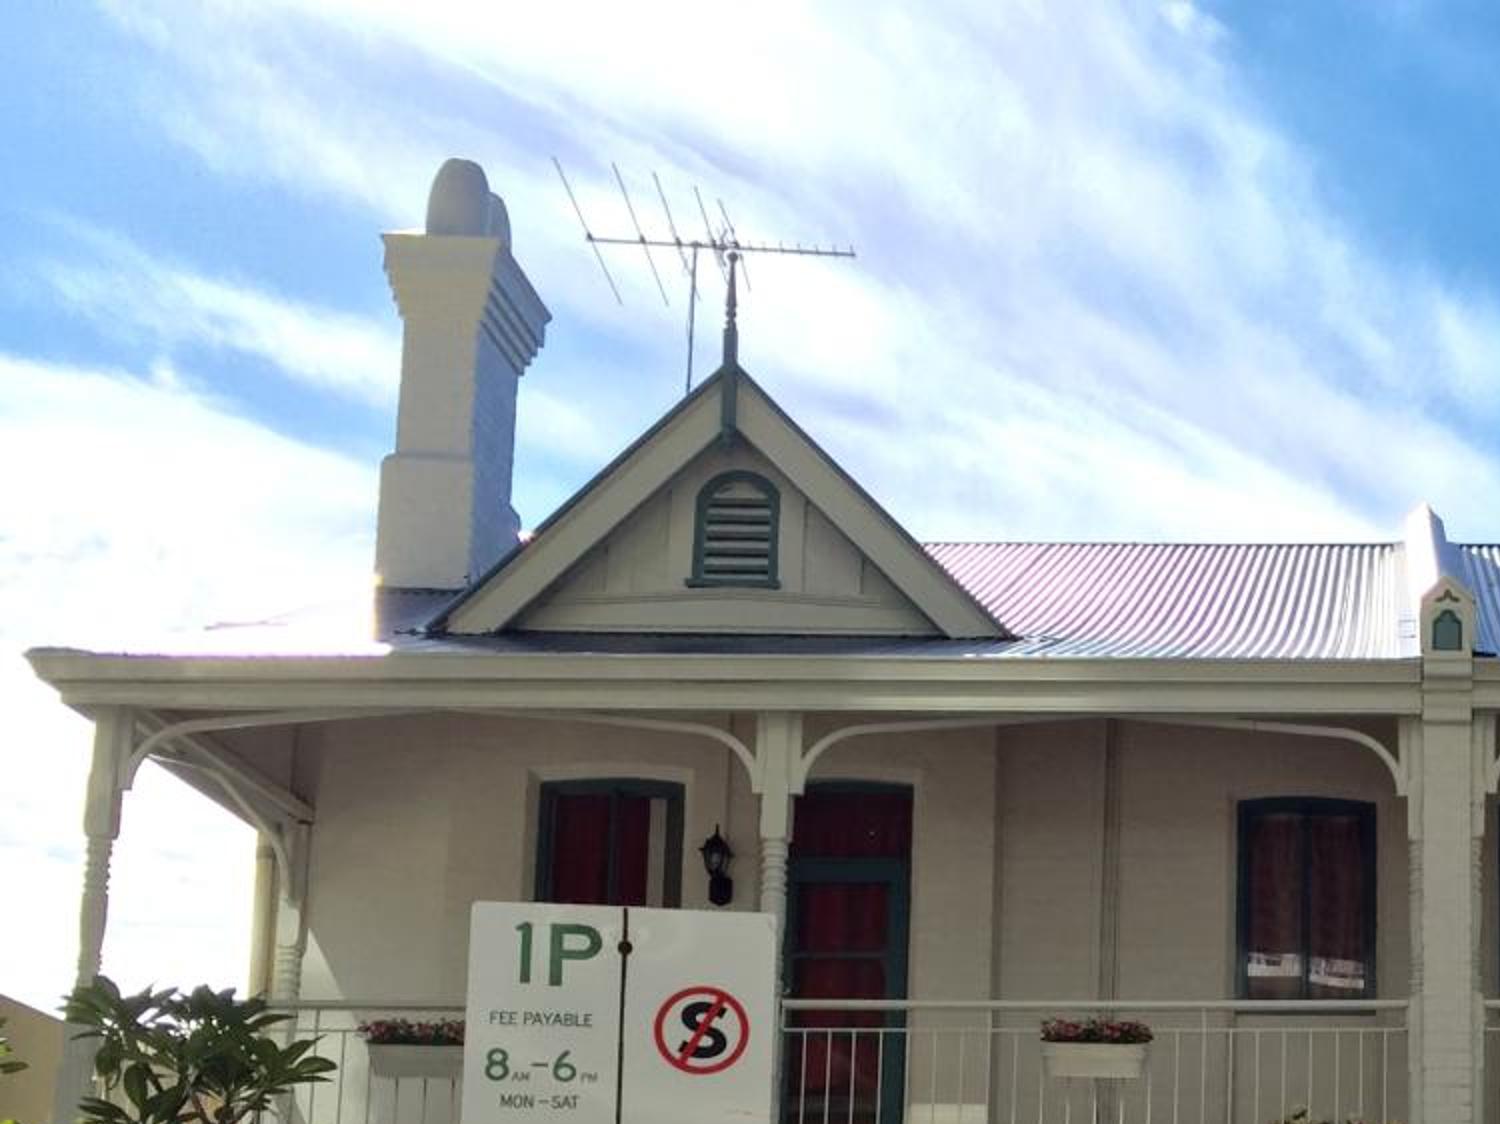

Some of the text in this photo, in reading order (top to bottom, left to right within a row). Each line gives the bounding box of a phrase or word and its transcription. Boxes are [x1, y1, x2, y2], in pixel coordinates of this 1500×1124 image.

[515, 921, 603, 987] 1P
[489, 1011, 593, 1028] FEE PAYABLE
